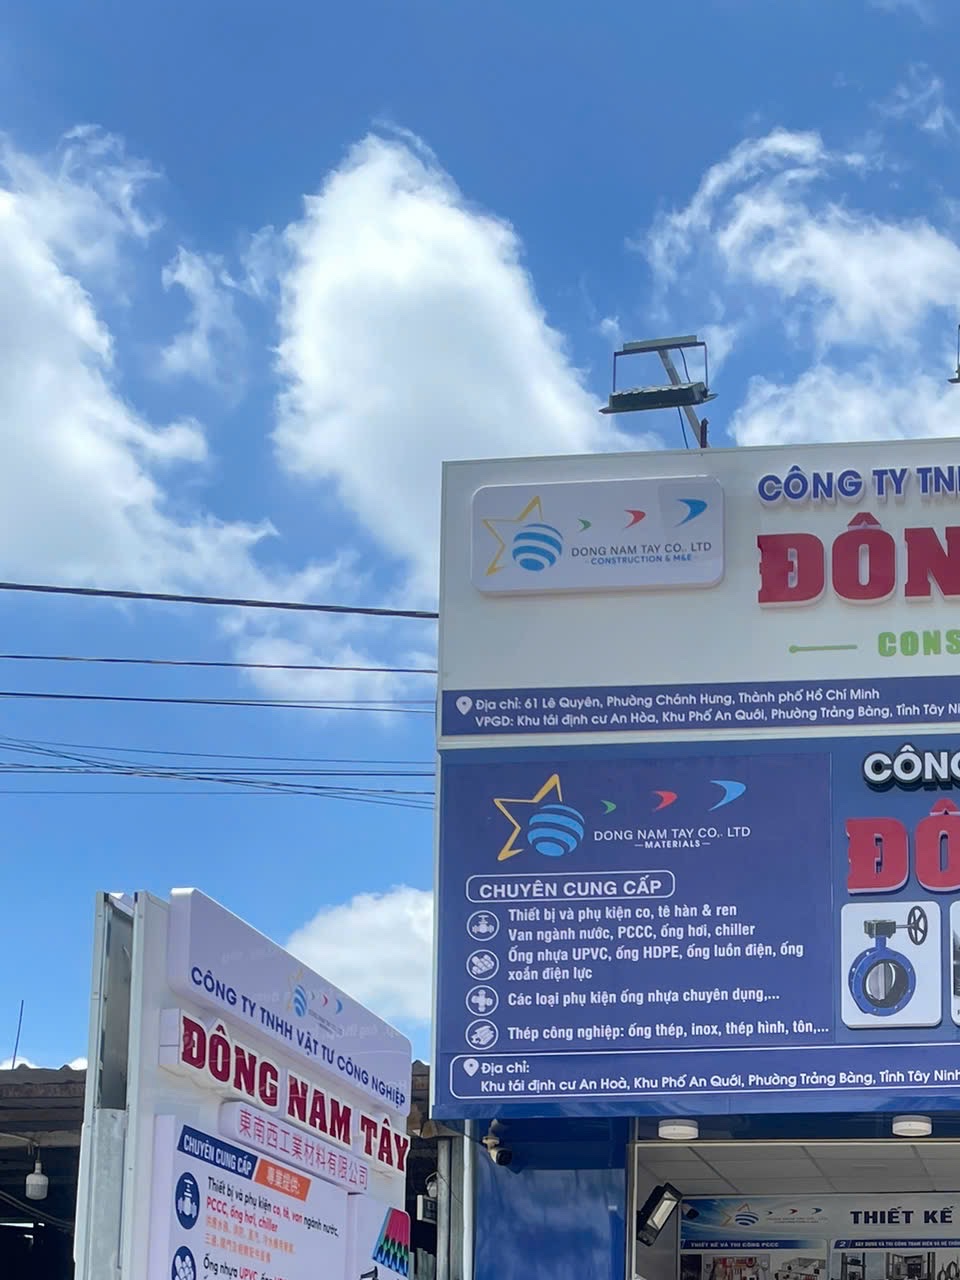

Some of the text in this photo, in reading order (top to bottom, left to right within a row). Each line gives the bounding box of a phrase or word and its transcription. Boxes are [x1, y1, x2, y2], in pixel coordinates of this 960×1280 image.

[758, 466, 863, 502] CÔNG
[873, 467, 907, 496] TY
[476, 688, 880, 712] Địa chỉ: 61 Lê Quyên, Phường Chánh Hưng, Thành phố Hồ Chí Minh
[594, 830, 633, 841] DONG
[637, 829, 667, 840] NAM
[671, 828, 694, 839] TAY
[727, 826, 751, 838] LTD
[645, 840, 700, 848] MATERIALS
[479, 874, 662, 899] CHUYÊN CUNG CẤP
[508, 923, 755, 943] Van ngành nước, PCCC, ống hơi, chiller
[508, 941, 803, 964] Ống nhựa UPVC, ống HDPE, ống luồn điện, ống
[508, 988, 780, 1007] Các loại phụ kiện ống nhựa chuyên dụng,...
[191, 966, 238, 1006] CÔNG
[241, 992, 258, 1015] TY
[259, 1005, 294, 1041] TNHH
[296, 1030, 320, 1058] VẬT
[321, 1045, 336, 1066] TƯ
[337, 1057, 368, 1085] CÔNG
[371, 1075, 406, 1109] NGHIỆP
[508, 1020, 829, 1042] Thép công nghiệp: ống thép, inox, thép hình, tôn,...
[182, 1015, 410, 1172] ĐÔNG NAM TÂY
[183, 1130, 252, 1176] CHUYÊN CUNG CẤP
[850, 1205, 914, 1224] THIẾT
[924, 1204, 953, 1224] KẾ
